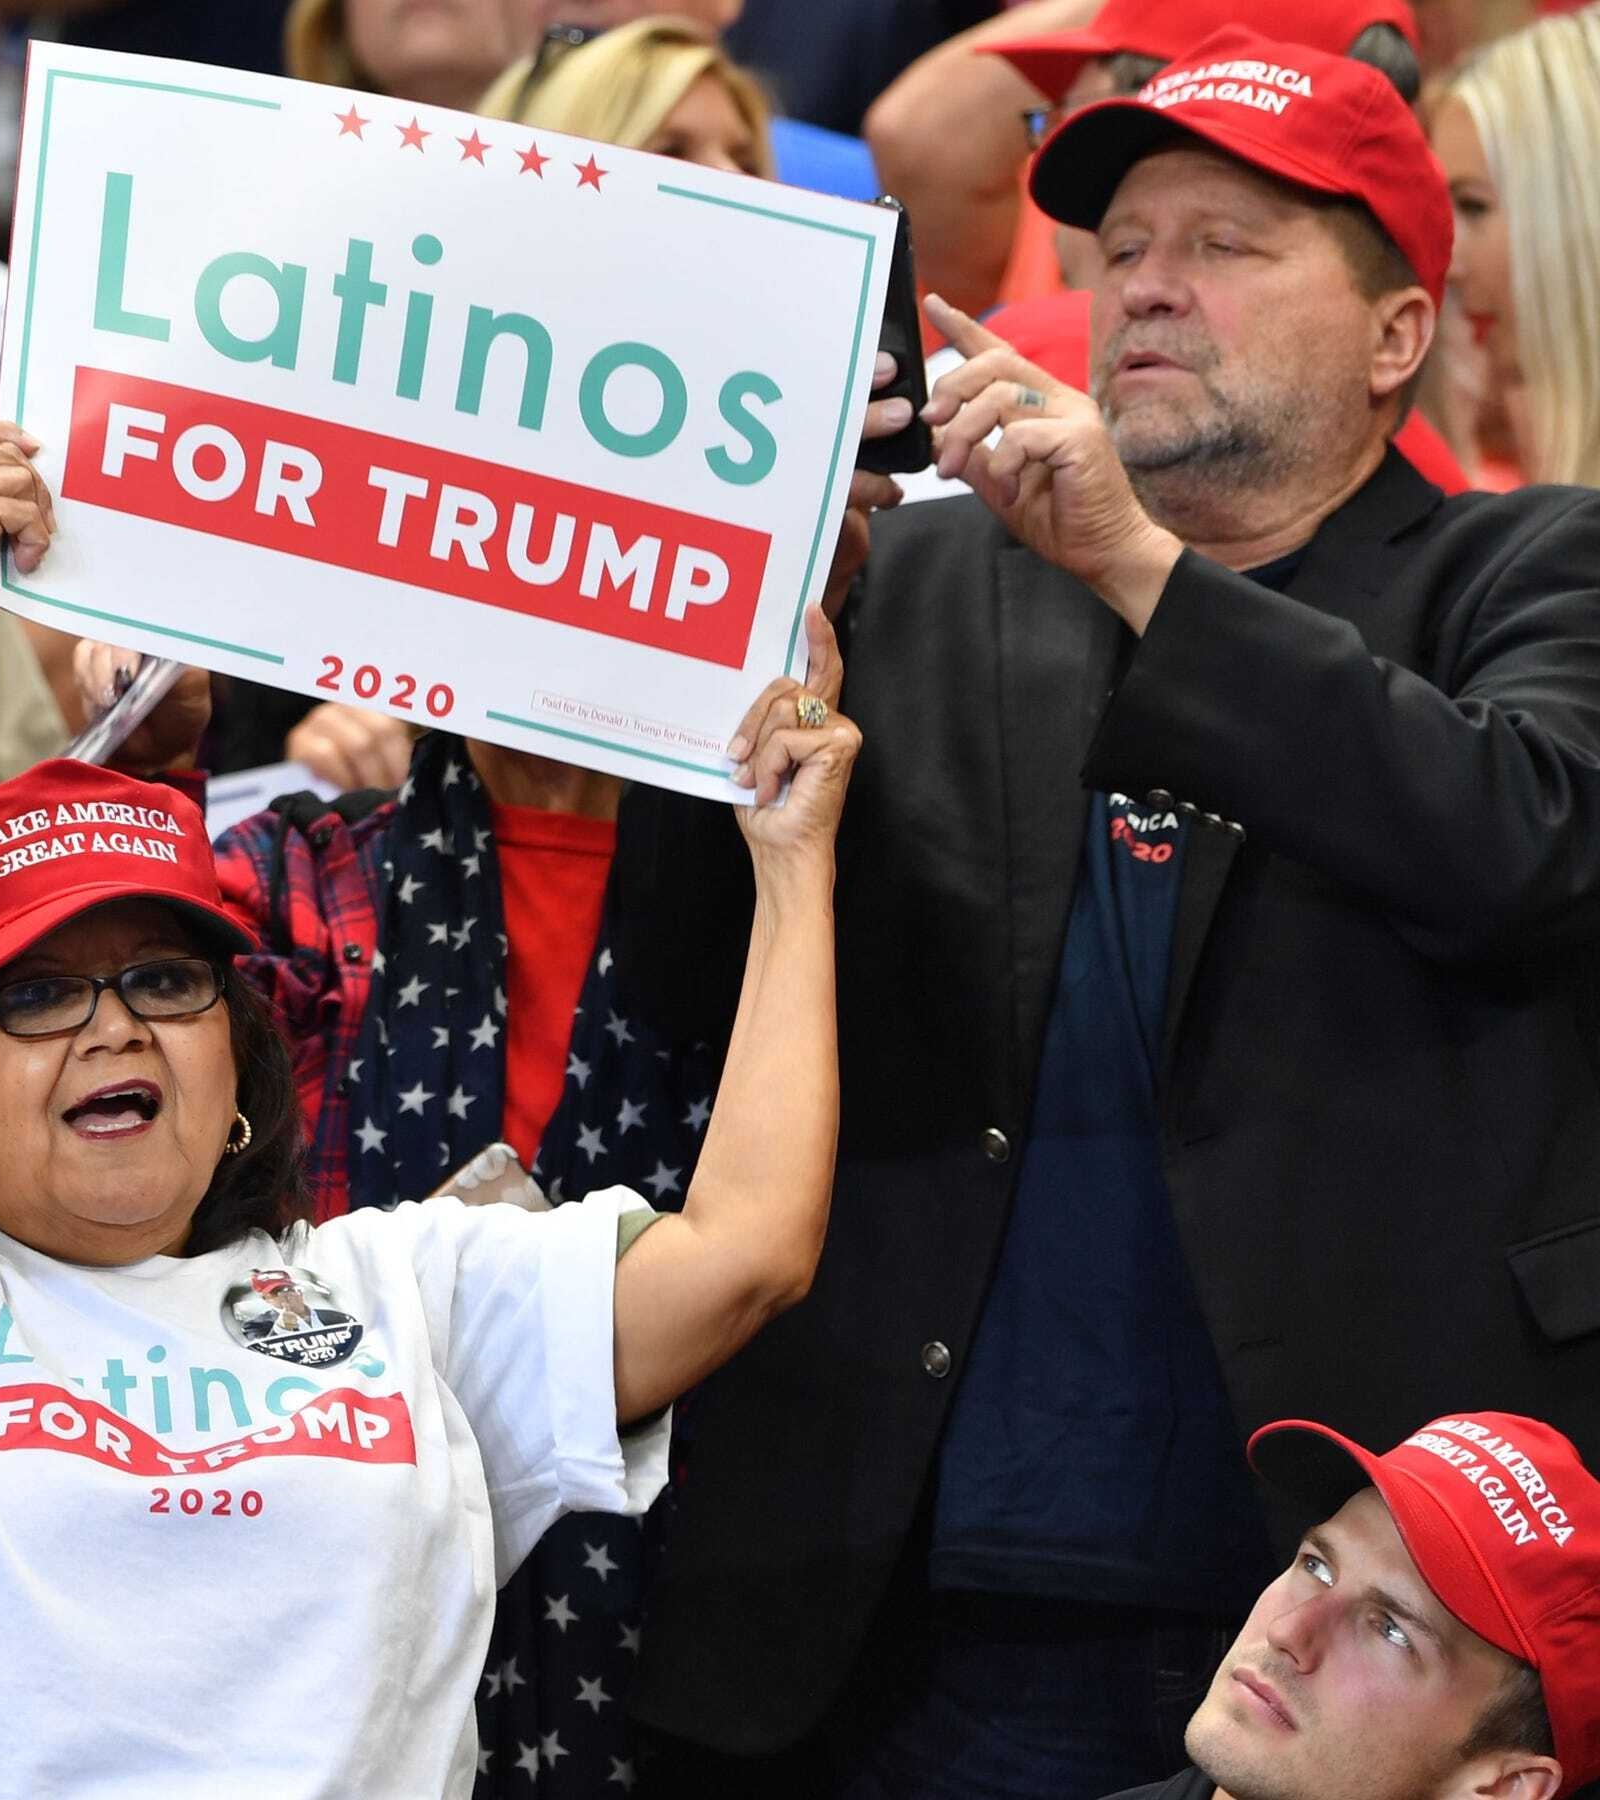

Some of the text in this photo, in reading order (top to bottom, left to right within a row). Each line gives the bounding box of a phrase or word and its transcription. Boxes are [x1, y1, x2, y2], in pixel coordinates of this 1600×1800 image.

[1191, 60, 1312, 98] AMERICA
[1196, 82, 1290, 116] AGAIN
[92, 171, 785, 487] Latinos
[101, 402, 731, 624] FOR TRUMP
[315, 654, 456, 719] 2020
[590, 709, 624, 728] Donald
[633, 720, 663, 738] Trump
[55, 801, 186, 837] AMERICA
[91, 831, 178, 864] AGAIN
[269, 1330, 352, 1357] TRUMP
[299, 1347, 337, 1364] 2020
[156, 1401, 390, 1475] TRUMP
[149, 1488, 263, 1518] 2020
[1460, 1464, 1538, 1546] AGAIN
[1474, 1436, 1575, 1547] AMERICA
